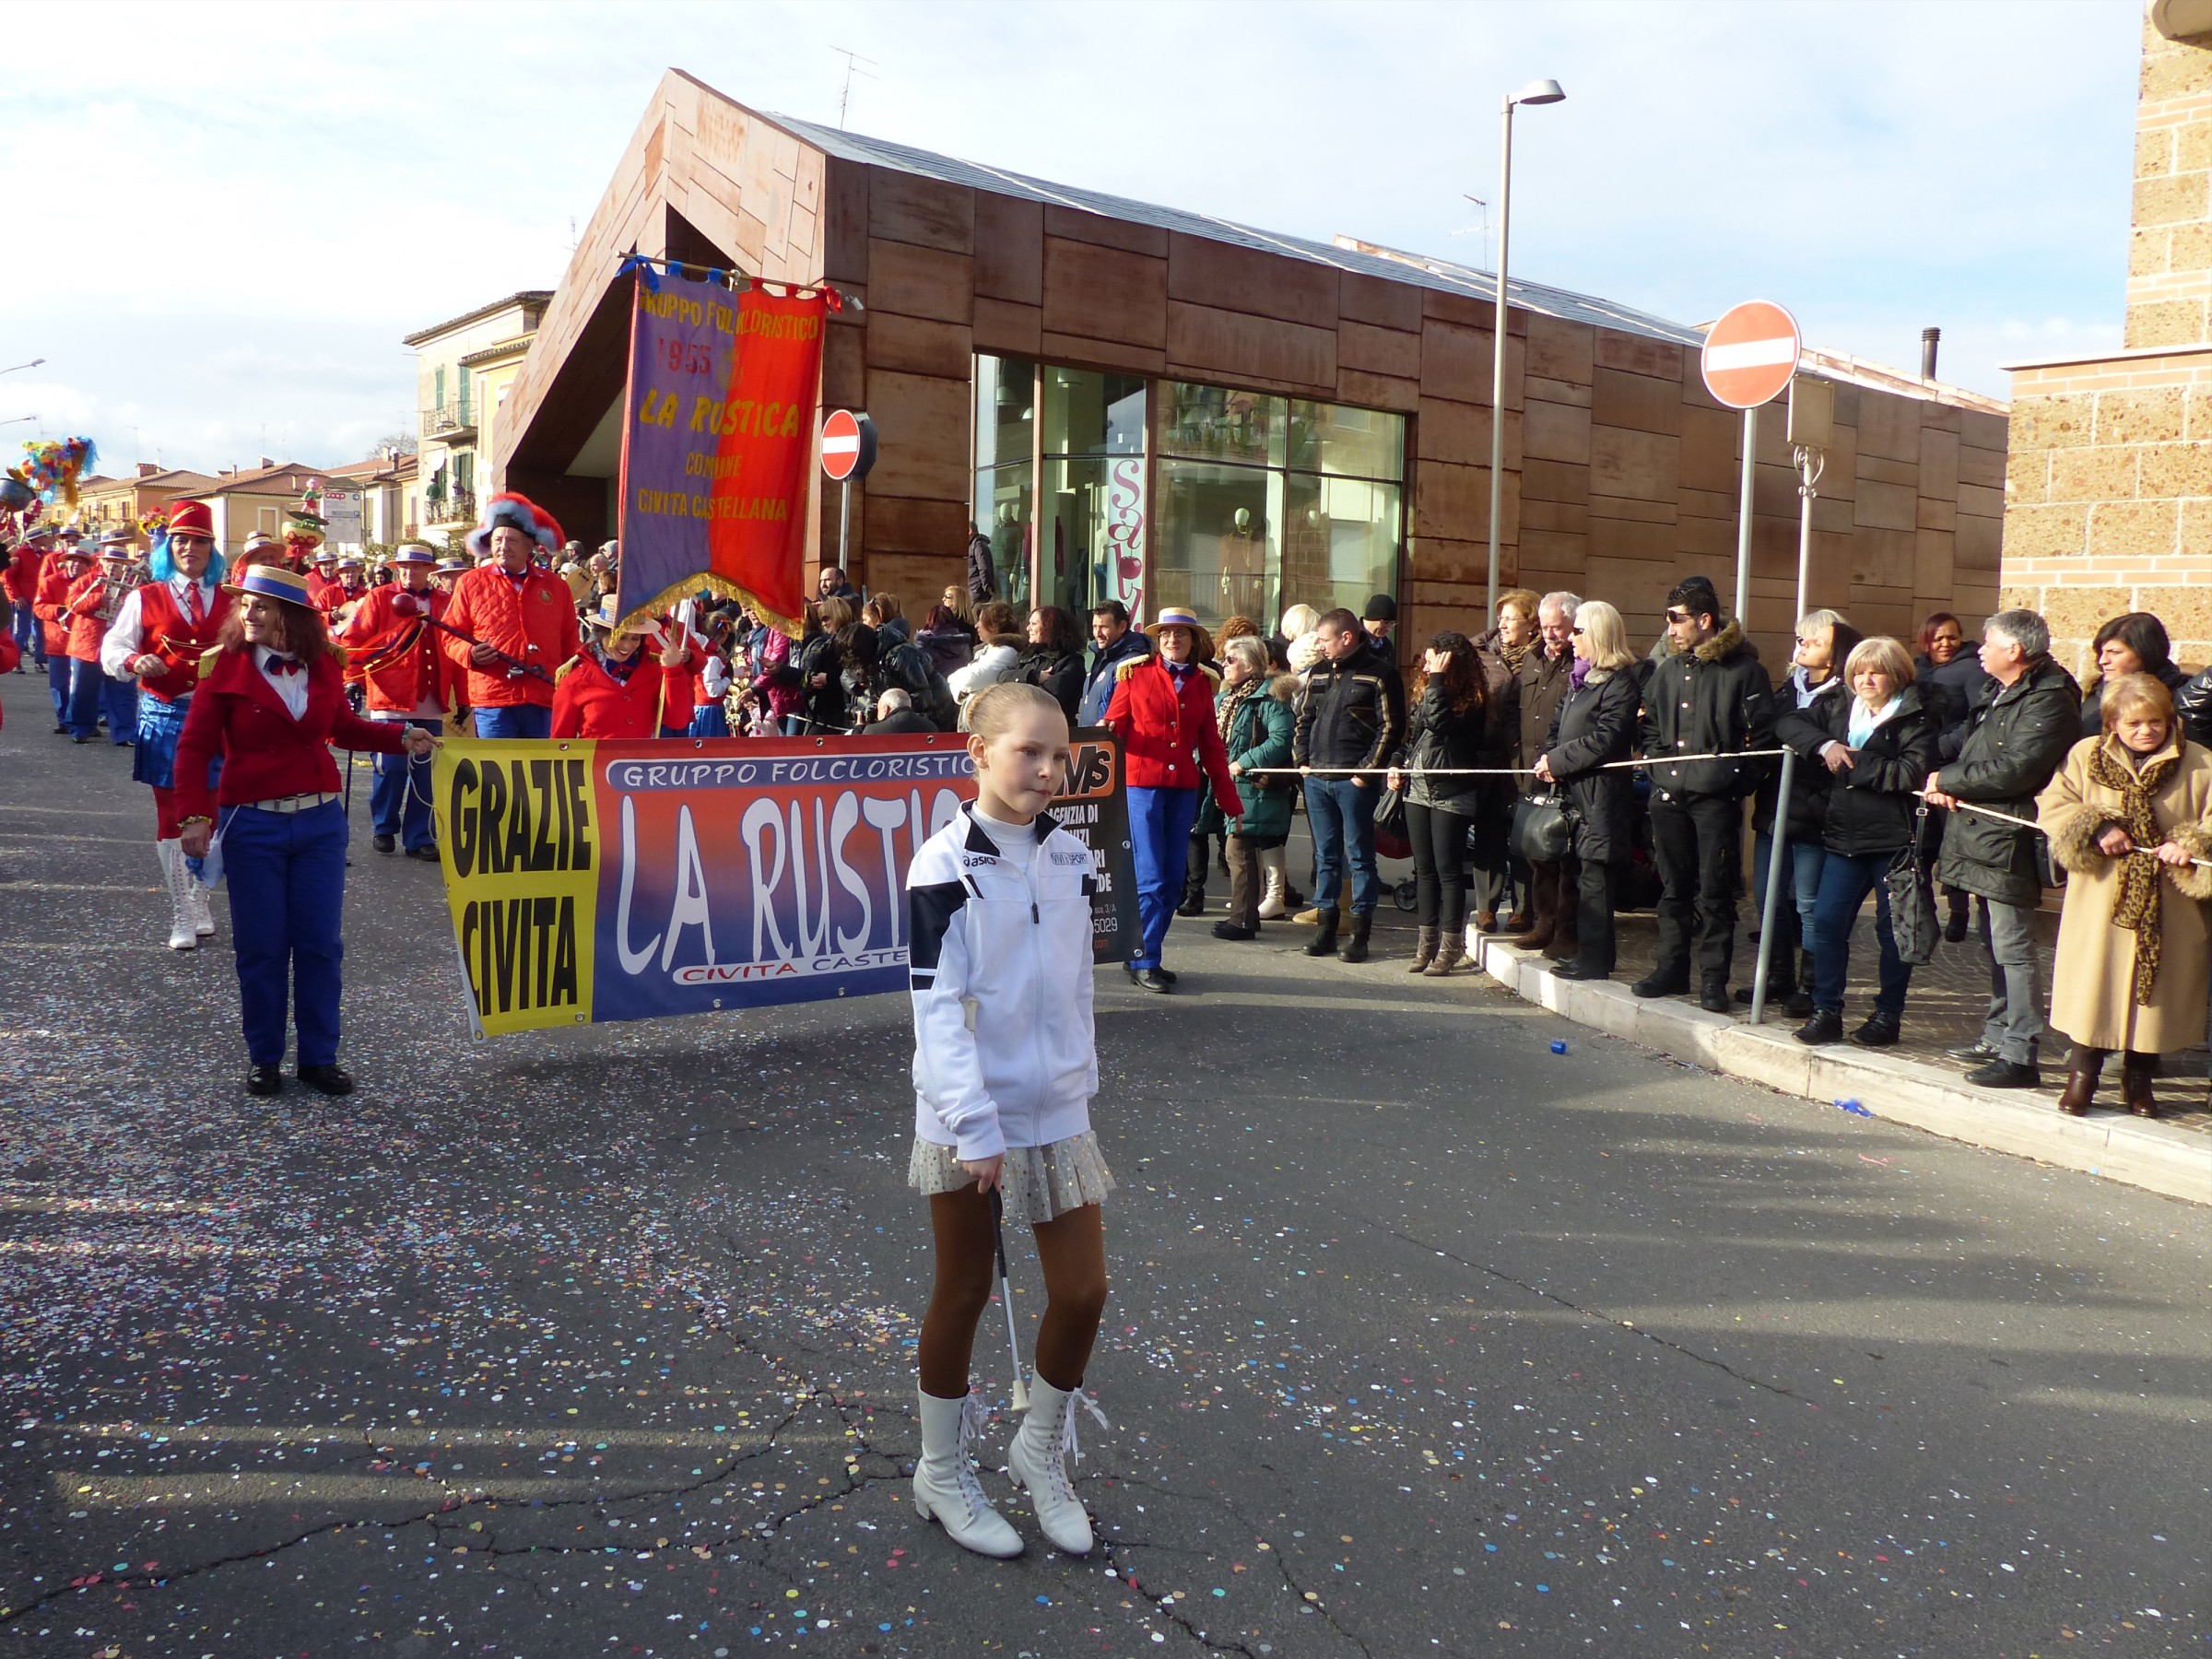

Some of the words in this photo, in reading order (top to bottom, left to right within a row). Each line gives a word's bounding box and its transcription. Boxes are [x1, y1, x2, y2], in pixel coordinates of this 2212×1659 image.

[707, 301, 818, 340] FOLKLORISTICO
[657, 338, 712, 375] 1955
[639, 388, 678, 429] LA
[689, 396, 799, 438] RUSTICA
[685, 452, 743, 480] COMUNE
[325, 492, 346, 500] coop
[638, 488, 688, 517] CIVITA
[692, 494, 788, 522] CASTELLANA
[624, 763, 757, 786] GRUPPO
[451, 758, 592, 877] GRAZIE
[1050, 805, 1085, 825] AGENZIA
[1088, 804, 1099, 823] DI
[971, 856, 996, 866] asics
[617, 794, 715, 975] LA
[462, 896, 578, 1017] CIVITA
[683, 962, 797, 982] CIVITA
